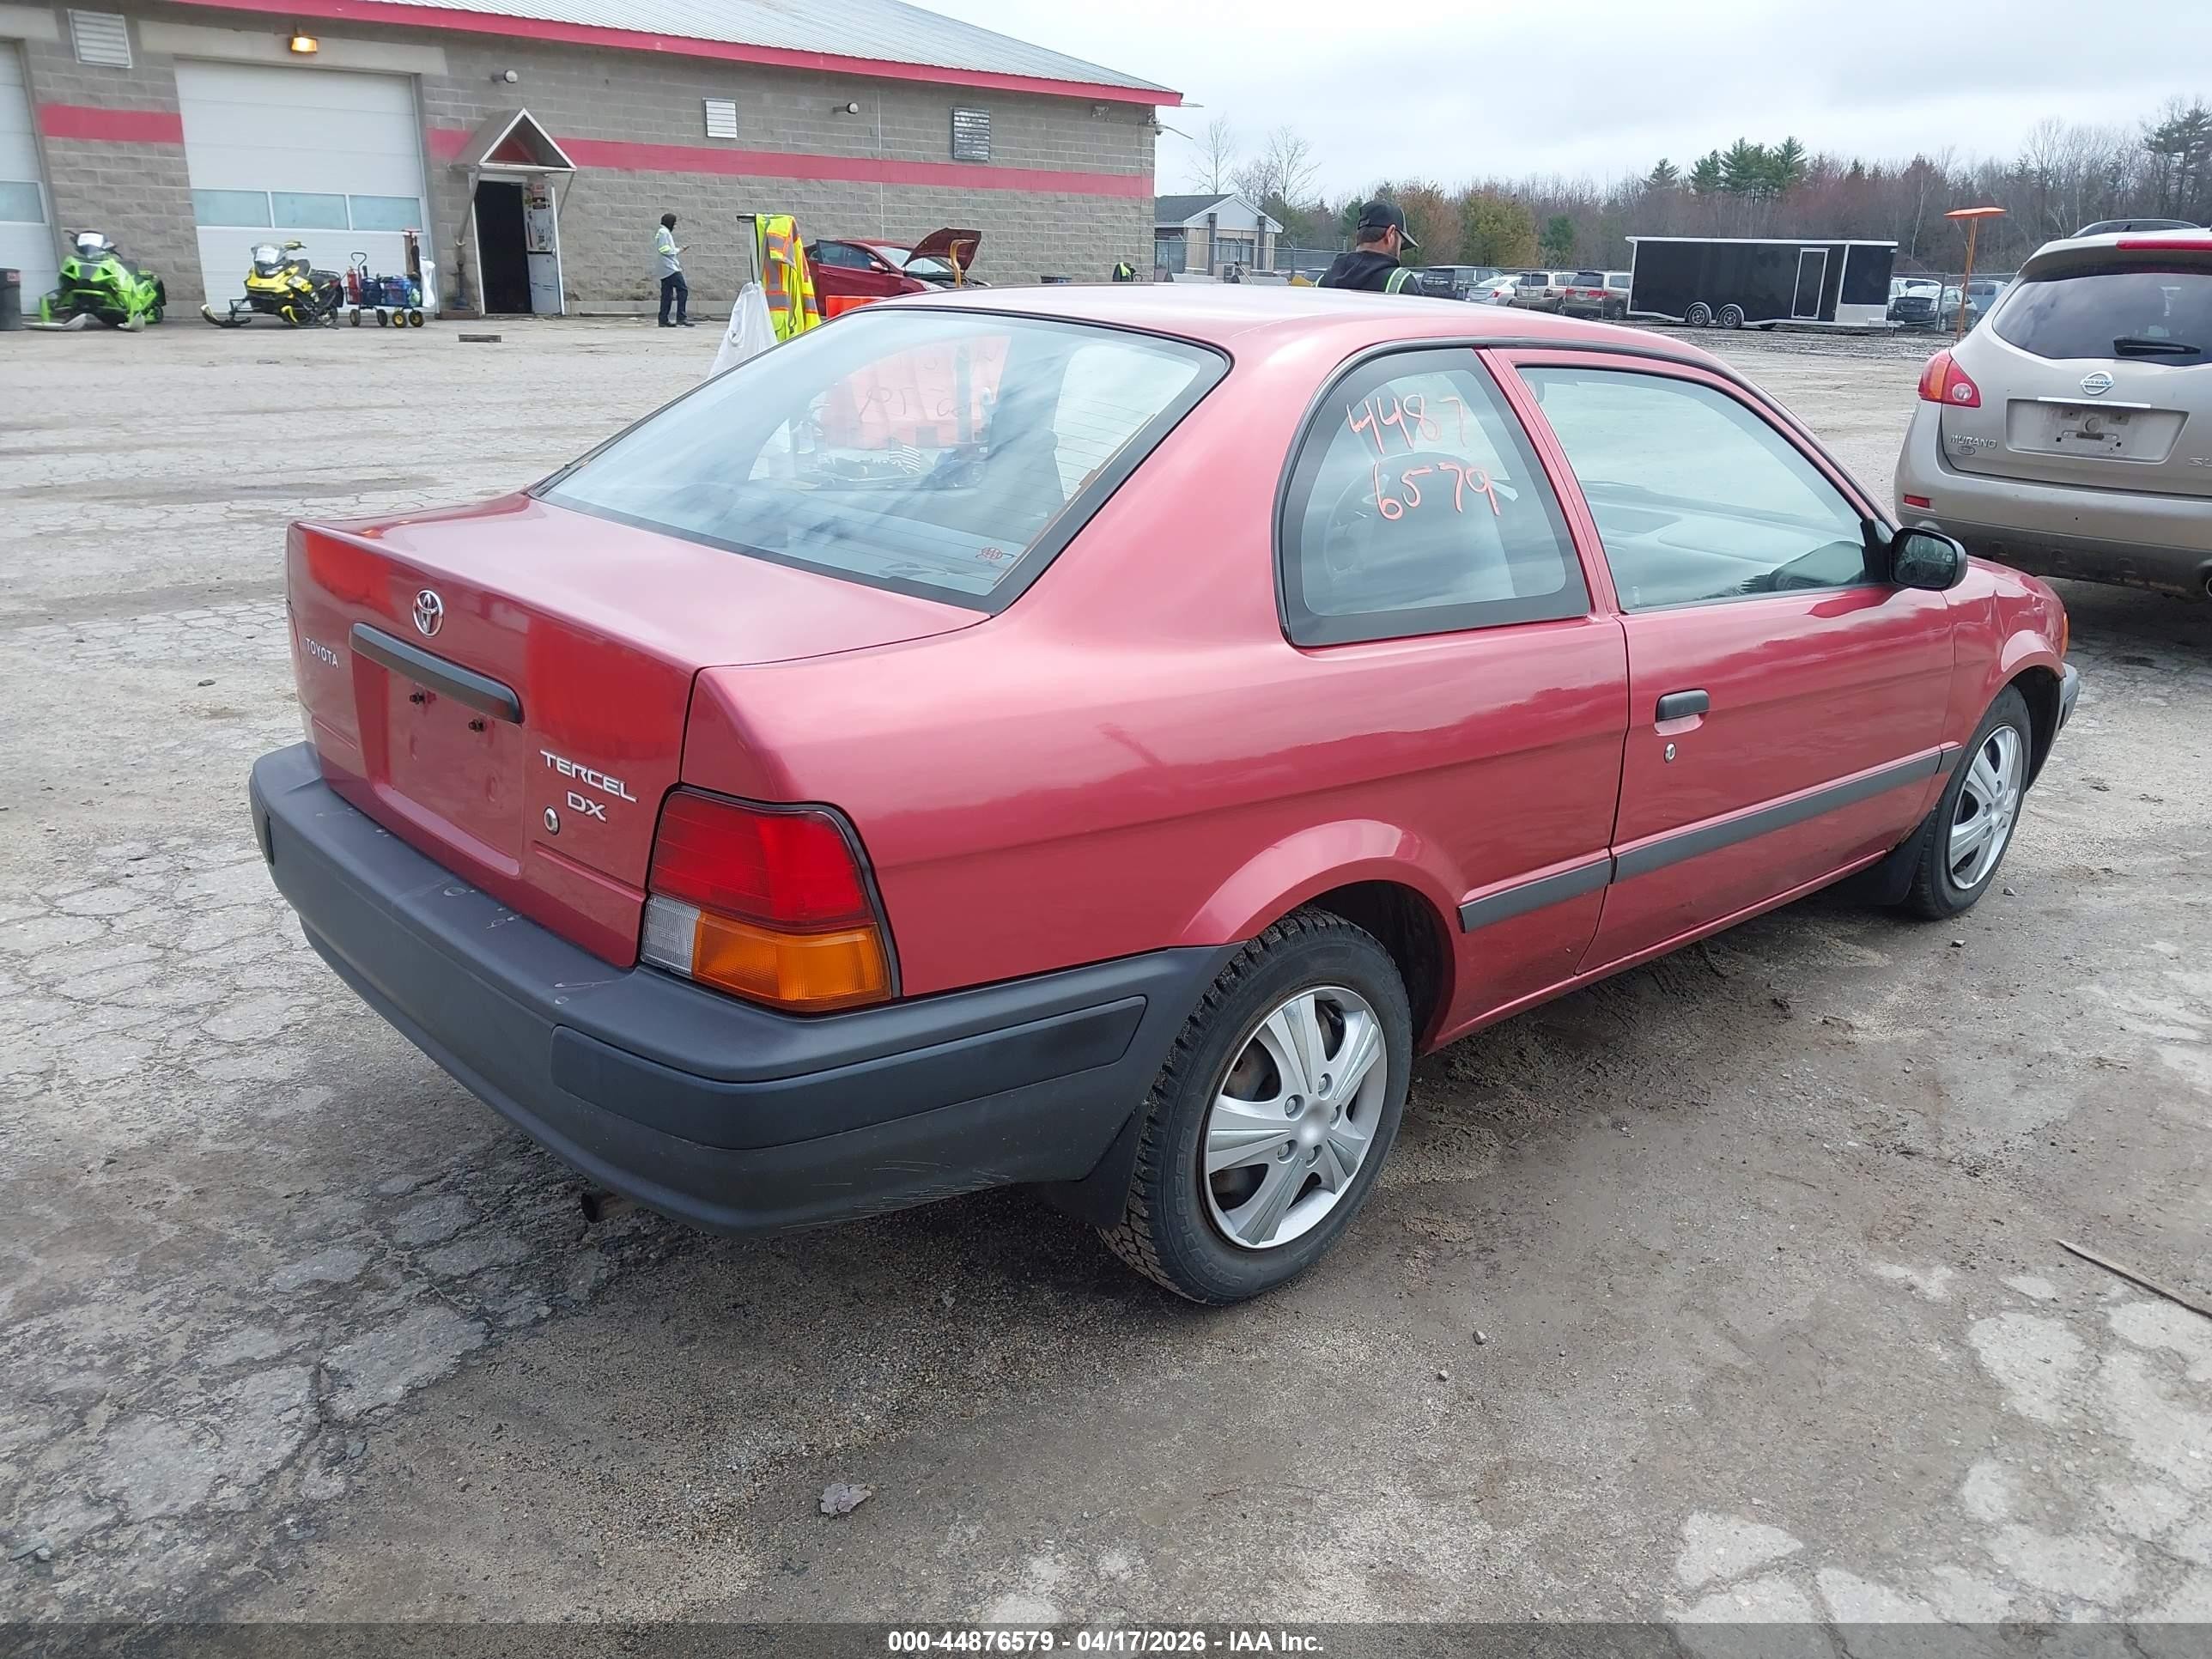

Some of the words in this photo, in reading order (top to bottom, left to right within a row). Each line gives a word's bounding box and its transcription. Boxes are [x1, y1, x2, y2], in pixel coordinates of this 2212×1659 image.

[1346, 392, 1468, 455] 4487
[1950, 434, 1998, 449] MURANO
[1371, 460, 1501, 520] 6579
[305, 637, 339, 668] TOYOTA
[539, 749, 638, 803] TERCEL
[567, 790, 607, 823] DX
